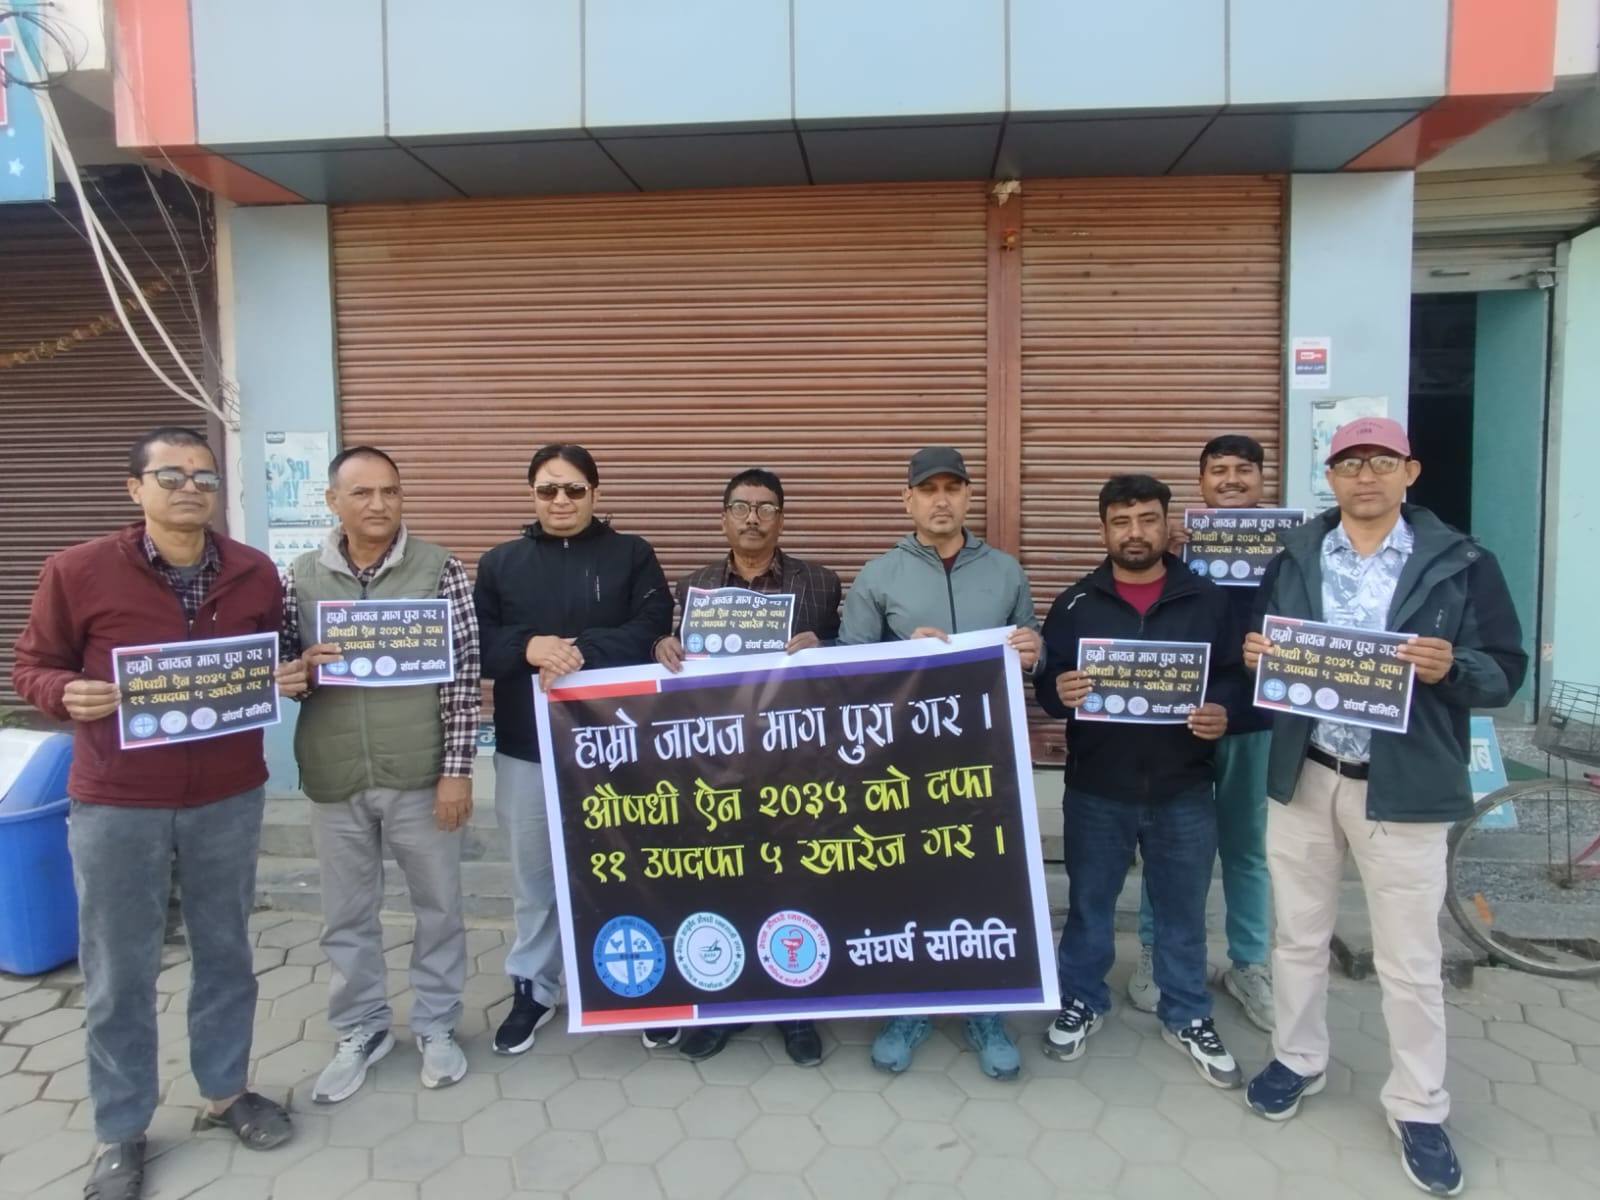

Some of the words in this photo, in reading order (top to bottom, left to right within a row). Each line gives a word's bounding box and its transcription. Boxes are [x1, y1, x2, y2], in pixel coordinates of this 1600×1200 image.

[571, 708, 638, 772] हाम्रो
[651, 715, 745, 760] जायज
[759, 707, 826, 752] माग
[838, 703, 894, 764] पुरा
[908, 695, 963, 737] गर
[582, 780, 680, 829] औषधी
[693, 777, 742, 832] ऐन
[759, 780, 848, 818] २०३५
[862, 765, 910, 812] को
[924, 765, 993, 804] दफा
[590, 851, 627, 883] ११
[641, 845, 744, 880] उपदफा
[760, 842, 783, 874] ५
[797, 824, 906, 874] खारेज
[921, 824, 975, 859] गर
[846, 922, 917, 966] संघर्ष
[924, 917, 1017, 961] समिति
